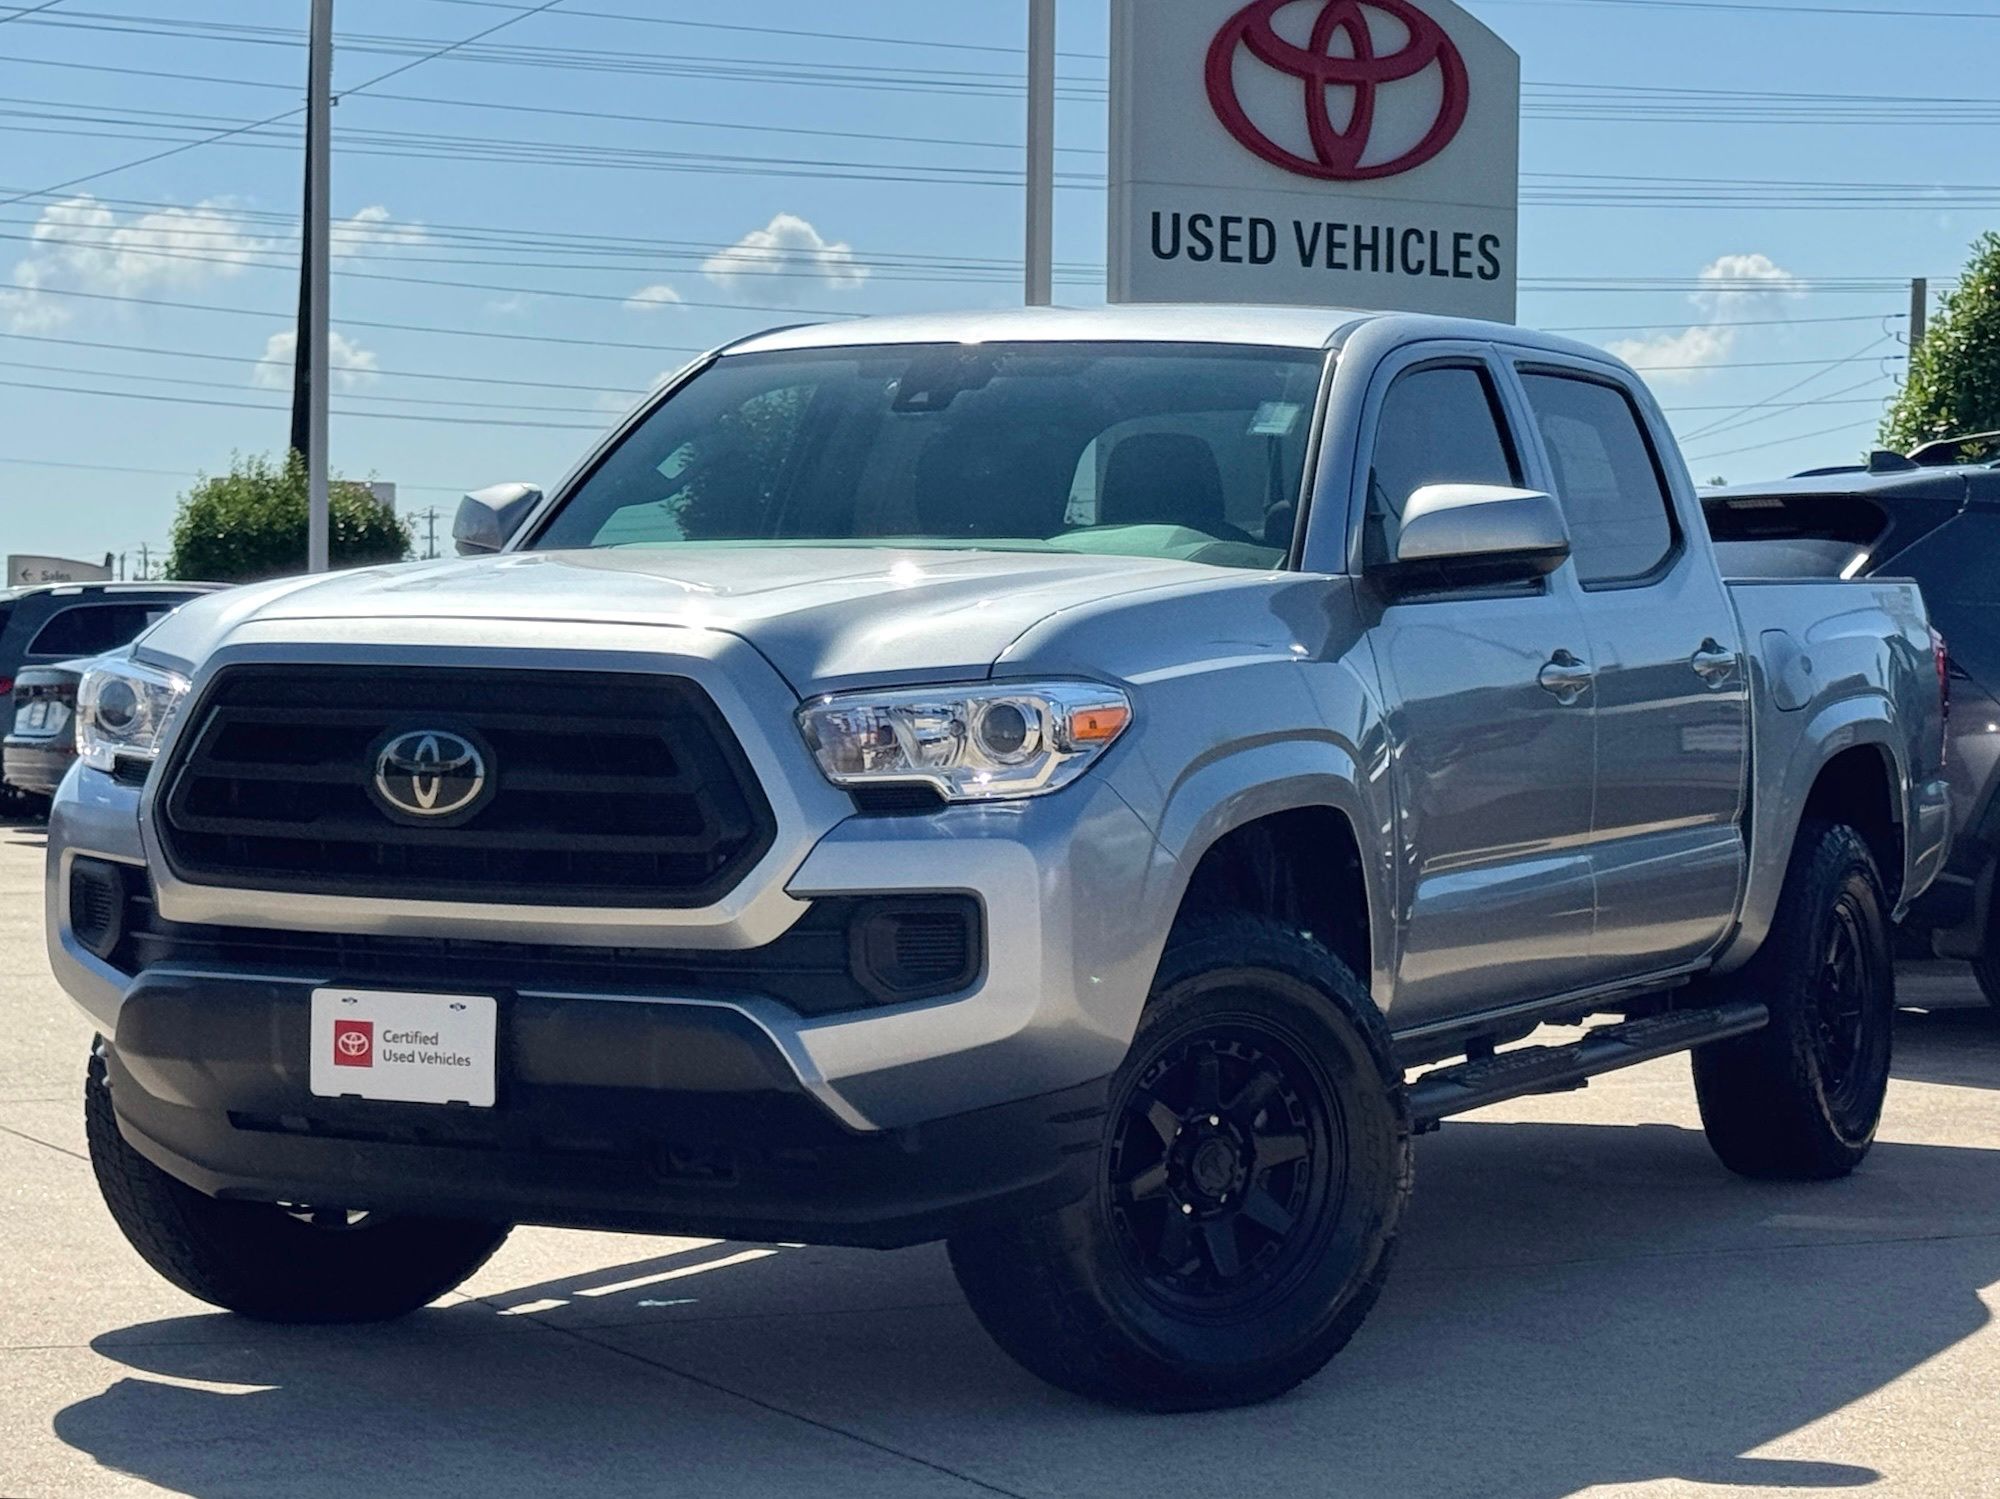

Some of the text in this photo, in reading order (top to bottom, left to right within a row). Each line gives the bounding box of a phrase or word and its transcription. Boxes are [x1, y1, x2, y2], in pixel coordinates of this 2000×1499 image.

[1151, 211, 1501, 281] USED VEHICLES
[41, 570, 71, 581] Sales
[383, 1030, 439, 1046] Certified
[383, 1049, 471, 1067] Used Vehicles
